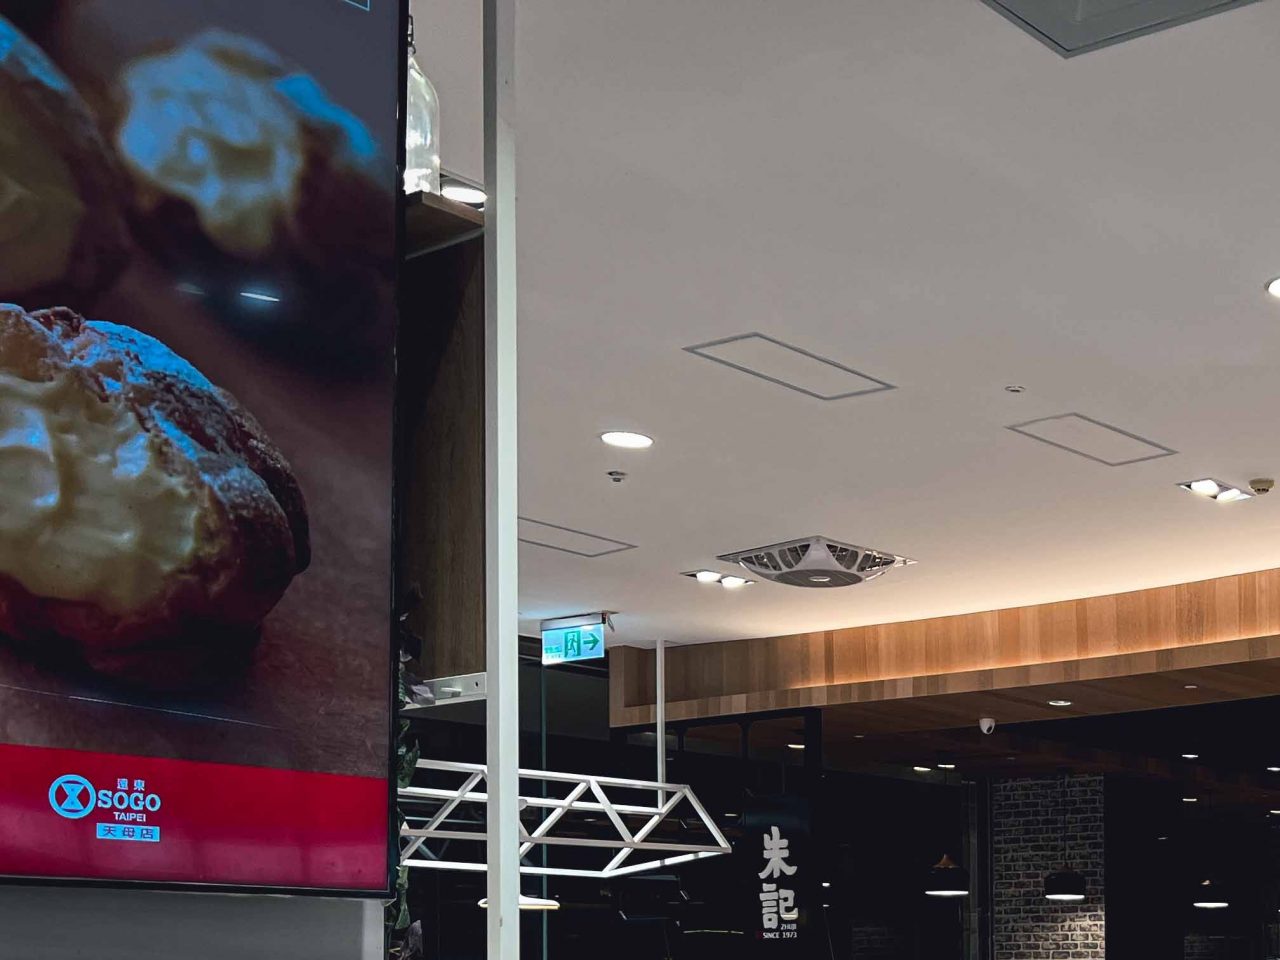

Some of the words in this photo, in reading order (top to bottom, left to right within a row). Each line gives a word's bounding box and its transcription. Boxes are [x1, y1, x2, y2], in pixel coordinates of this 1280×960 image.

[97, 789, 161, 811] SOGO
[113, 811, 146, 822] TAIPEI
[103, 825, 154, 840] 天母店
[758, 825, 799, 929] 朱記
